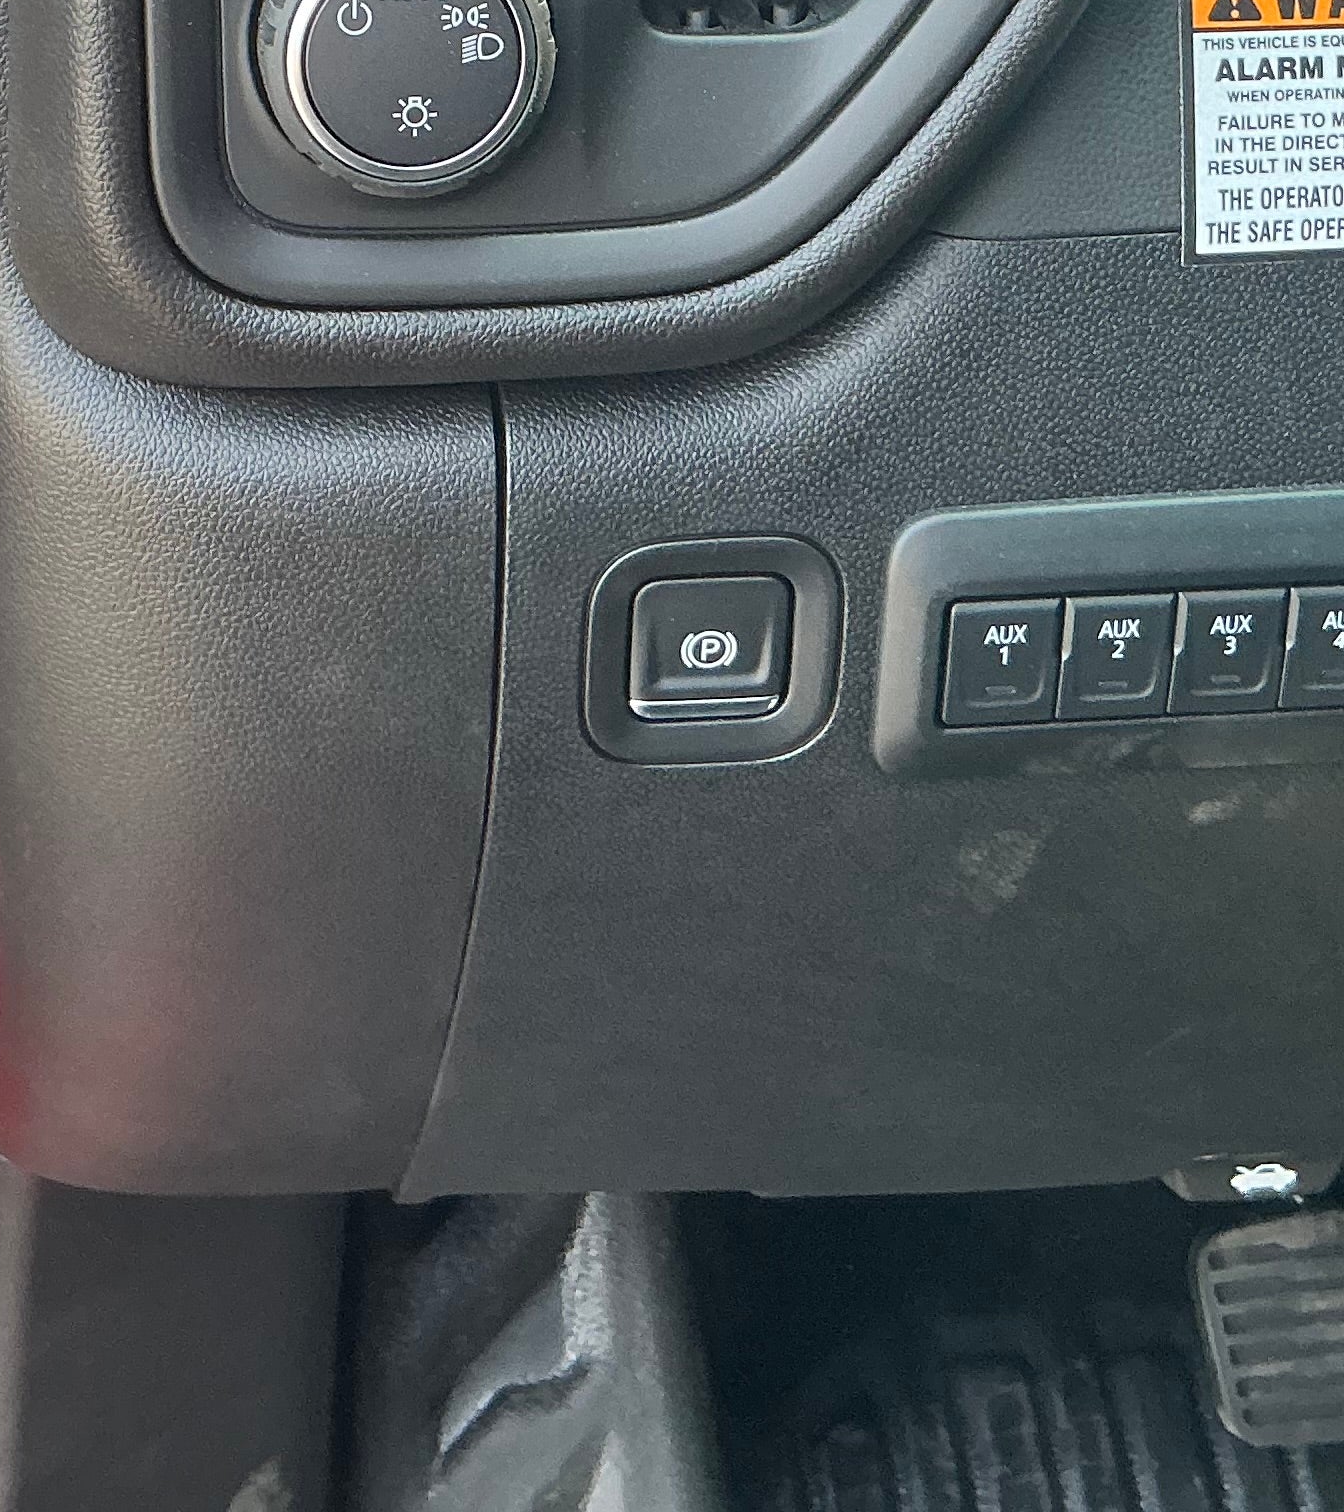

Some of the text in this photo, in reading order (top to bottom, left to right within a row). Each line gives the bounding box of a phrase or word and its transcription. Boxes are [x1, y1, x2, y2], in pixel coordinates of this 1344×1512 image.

[1203, 38, 1234, 51] THIS
[1238, 36, 1299, 49] VEHICLE
[1303, 35, 1316, 47] IS
[1215, 56, 1324, 82] ALARM
[1227, 90, 1271, 103] WHEN
[1218, 114, 1295, 131] FAILURE
[1301, 112, 1325, 128] TO
[1214, 138, 1233, 153] IN
[1240, 136, 1276, 152] THE
[1207, 159, 1279, 176] RESULT
[1284, 158, 1303, 173] IN
[1217, 188, 1254, 211] THE
[1205, 221, 1241, 245] THE
[1247, 219, 1294, 243] SAFE
[983, 624, 1029, 645] AUX
[1097, 619, 1141, 640] AUX
[1209, 614, 1253, 635] AUX
[999, 646, 1011, 665] 1
[1112, 639, 1124, 659] 2
[1223, 635, 1236, 656] 3
